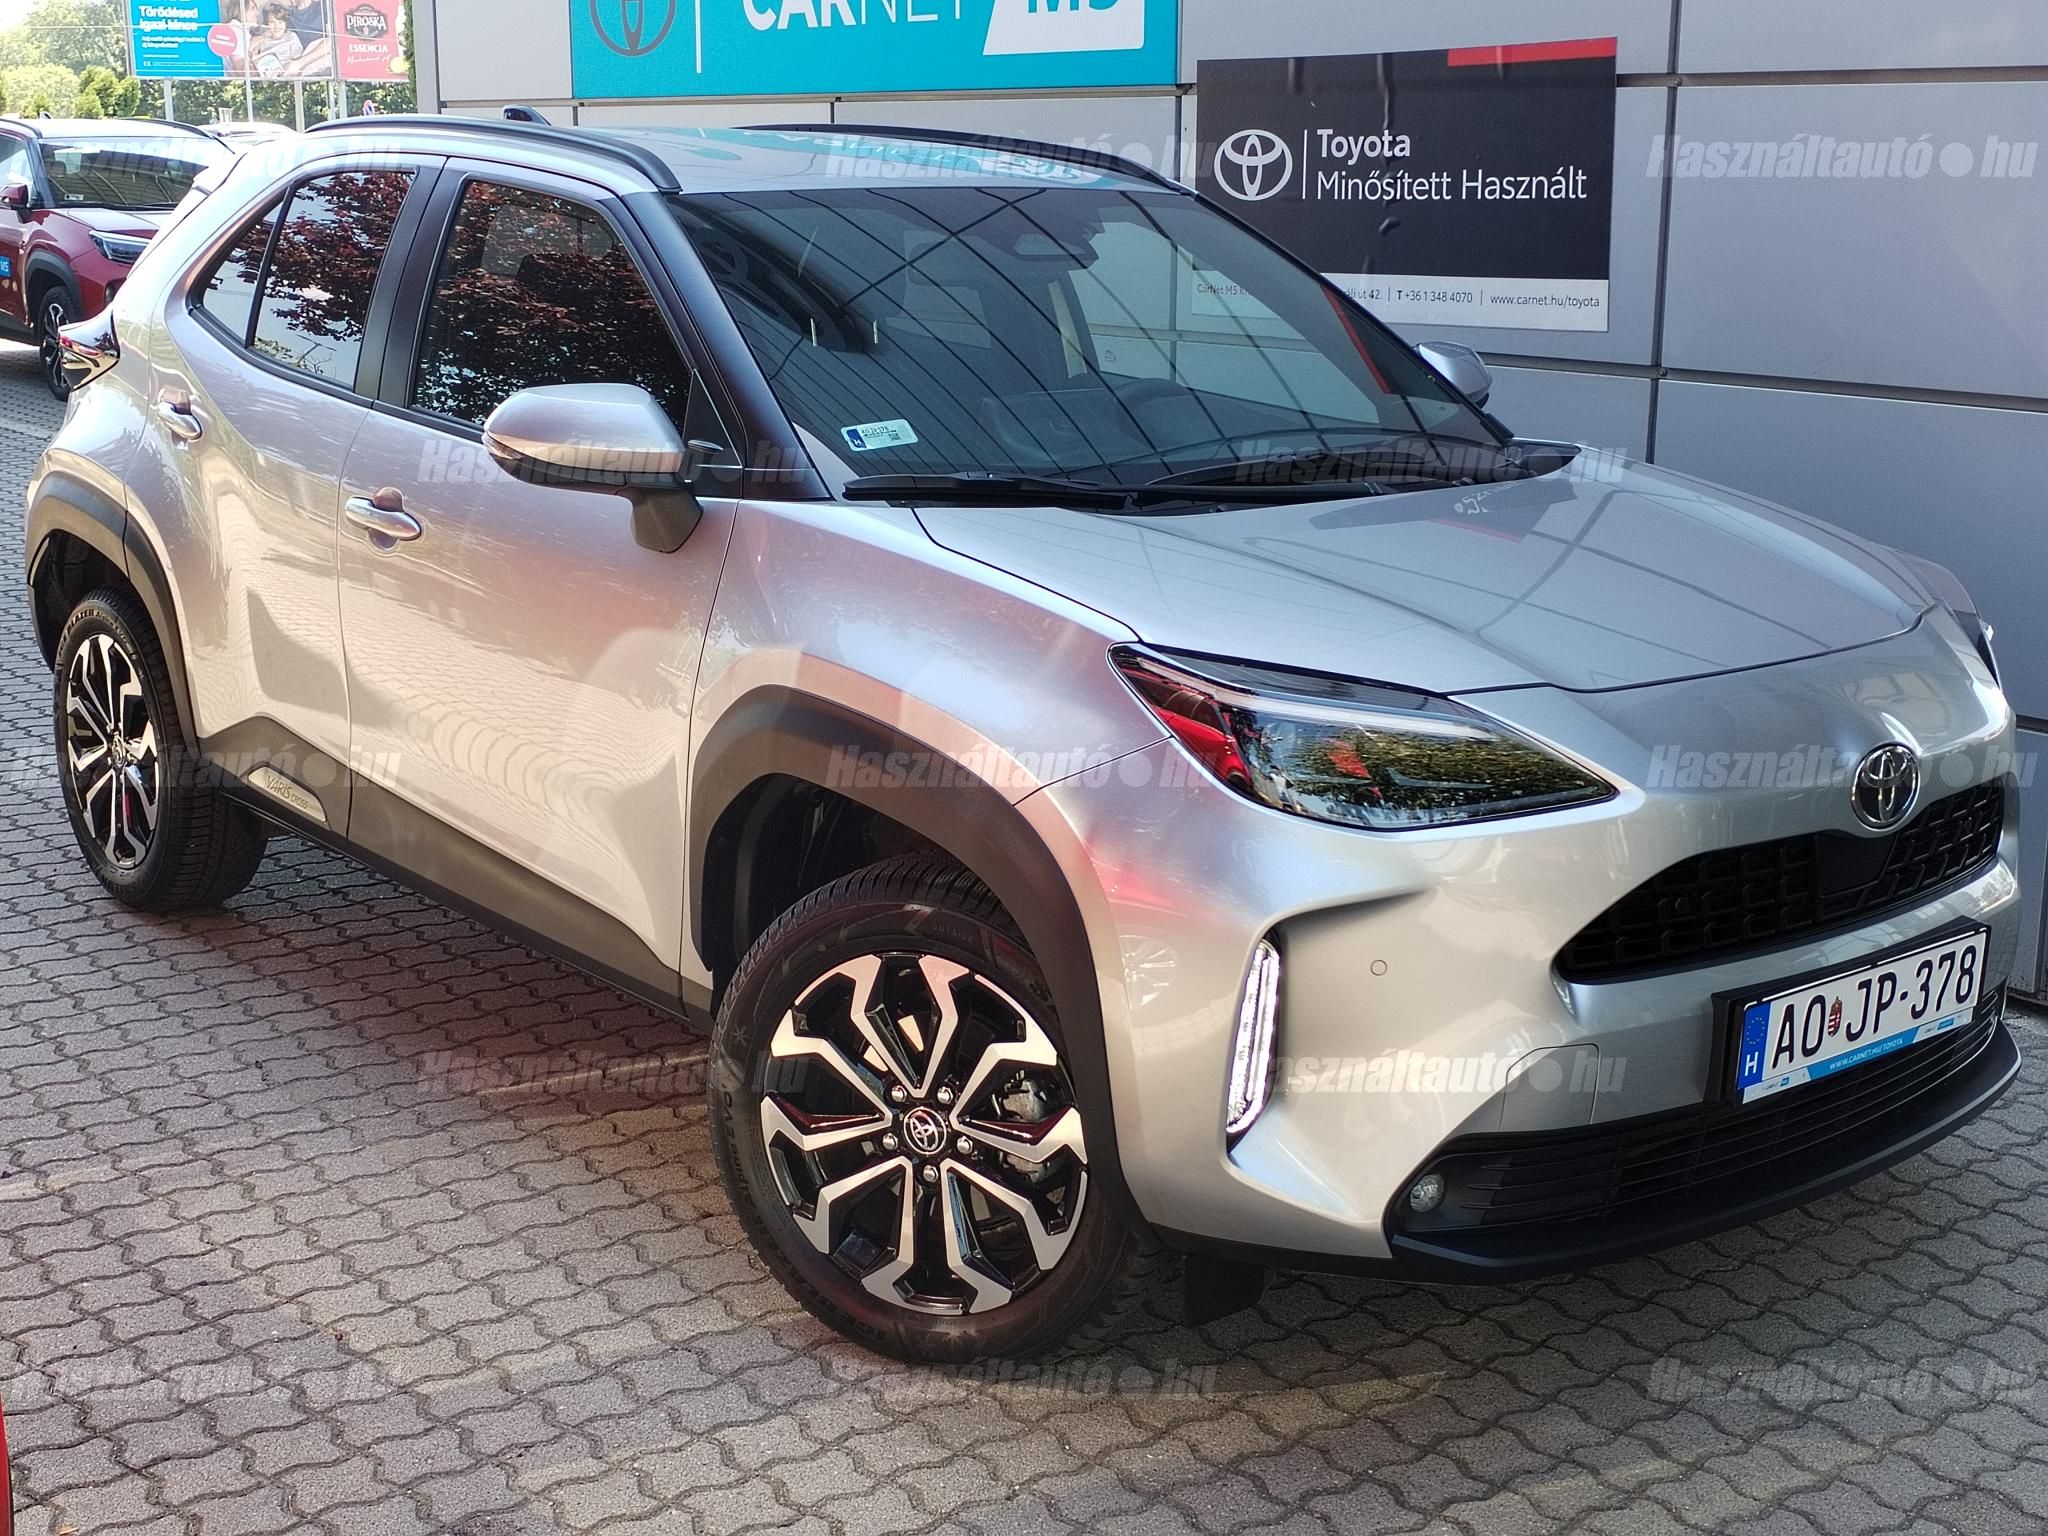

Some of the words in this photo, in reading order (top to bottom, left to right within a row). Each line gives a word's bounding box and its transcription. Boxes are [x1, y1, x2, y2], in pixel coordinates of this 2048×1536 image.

[1316, 128, 1411, 166] Toyota
[1317, 169, 1452, 200] Minősített
[1461, 166, 1588, 200] Használt
[1405, 290, 1422, 301] +36
[1431, 291, 1448, 302] 348
[1449, 292, 1473, 303] 4070
[1490, 294, 1600, 309] www.carnet.hu/toyota
[1771, 994, 1827, 1070] AO
[1845, 944, 1977, 1042] JP-378
[1744, 1052, 1758, 1077] H
